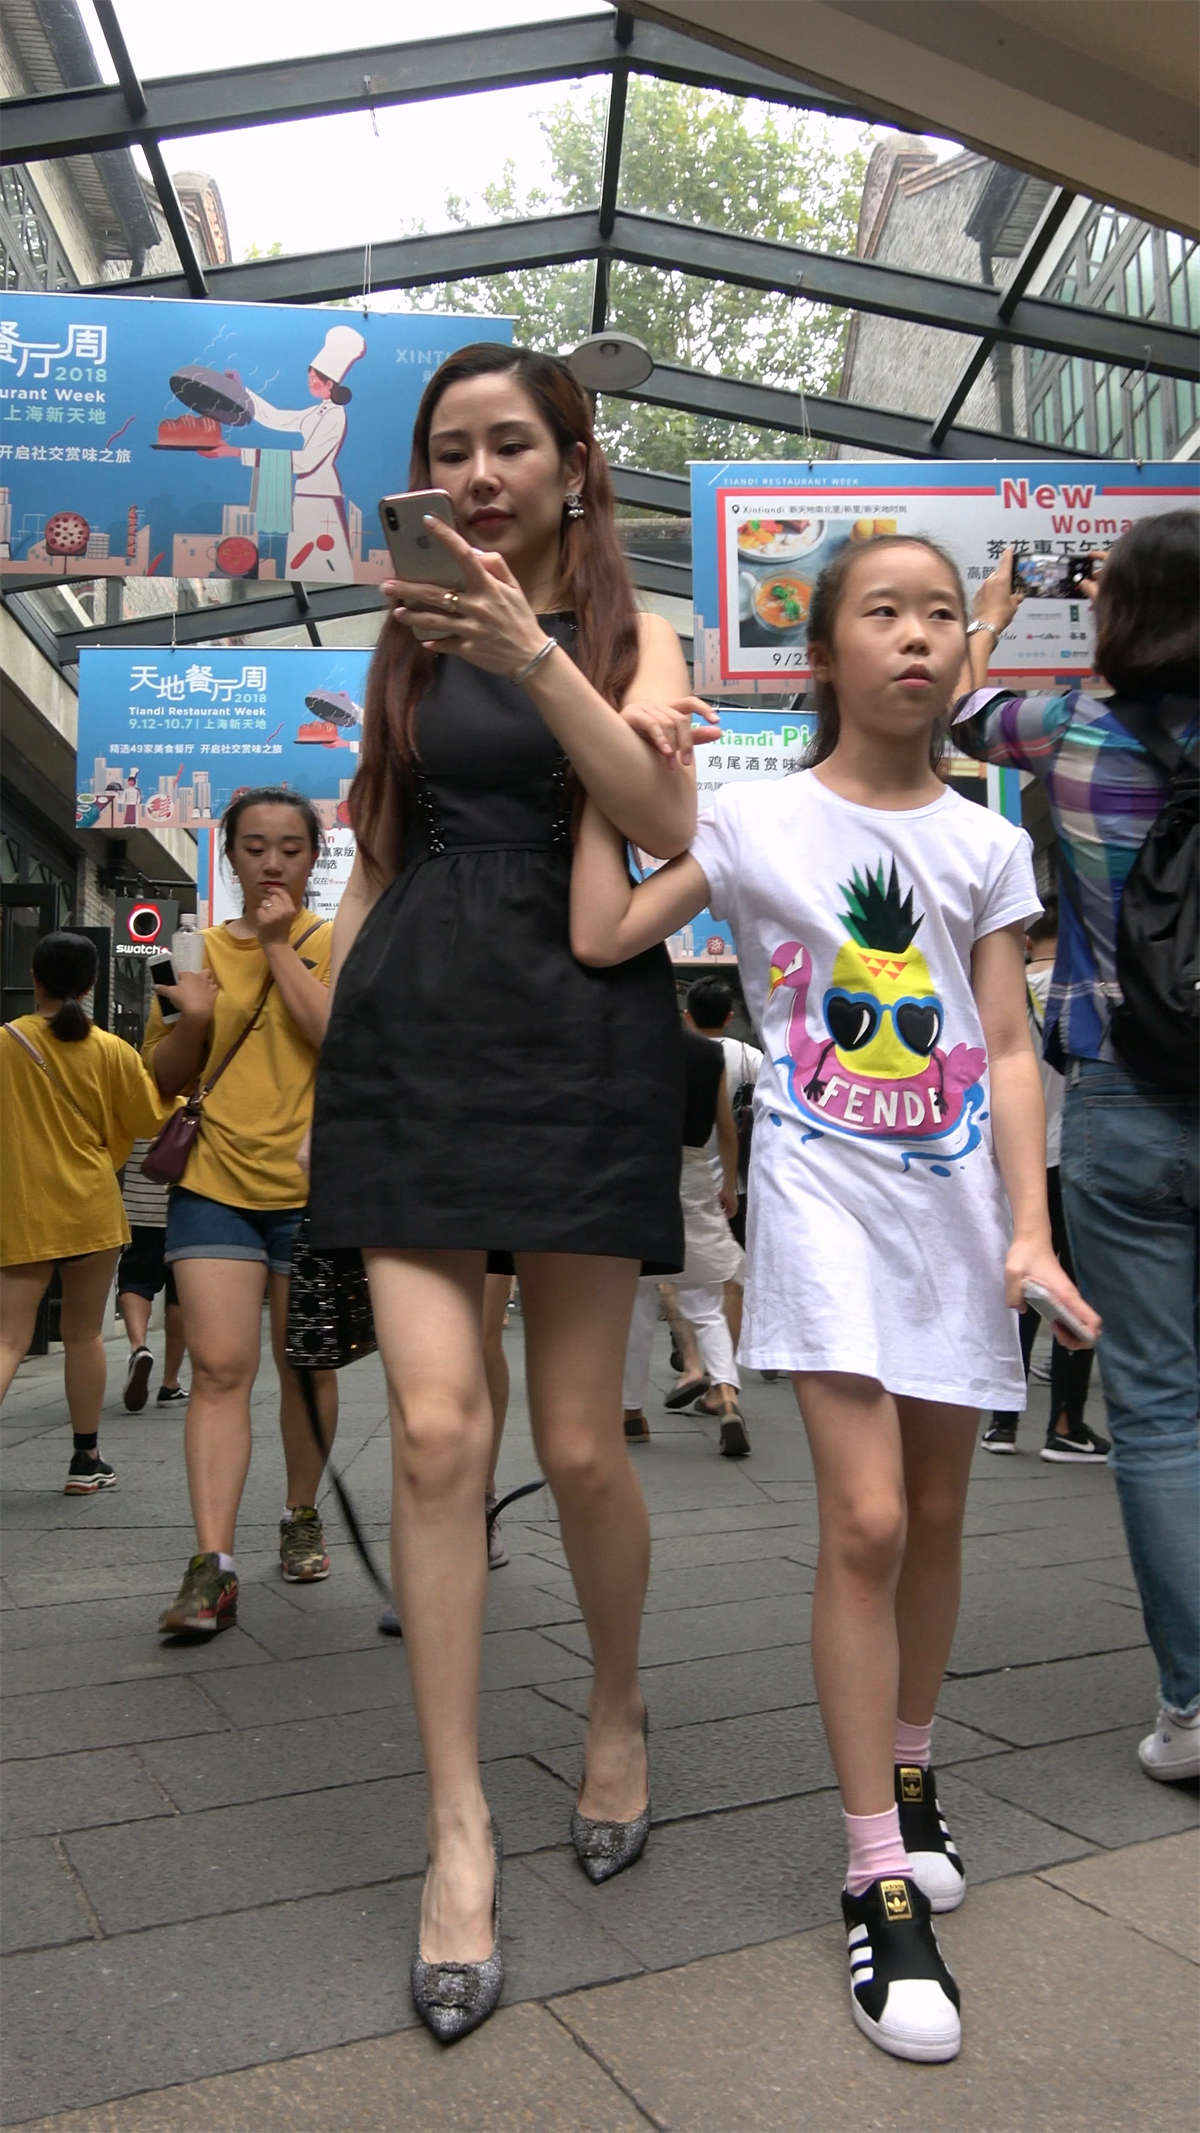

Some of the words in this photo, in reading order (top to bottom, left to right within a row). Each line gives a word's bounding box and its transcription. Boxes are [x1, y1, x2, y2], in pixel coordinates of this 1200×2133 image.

[395, 349, 450, 365] XINT
[55, 366, 107, 383] 2018
[55, 388, 106, 403] Week
[4, 404, 106, 424] 上海新天地
[0, 445, 132, 463] 开启社交赏味之旅
[762, 478, 828, 486] RESTAURANT
[831, 478, 860, 486] WEEK
[1002, 480, 1095, 509] New
[129, 664, 267, 702] 天地餐厅周
[235, 693, 267, 703] 2018
[129, 706, 165, 716] Tiandi
[168, 706, 231, 716] Restaurant
[235, 706, 267, 716] Week
[129, 718, 192, 730] 9.12-10.7
[205, 718, 267, 730] 上海新天地
[712, 729, 774, 746] tiandi
[200, 743, 283, 755] 开启社交赏味之旅
[707, 756, 797, 771] 鸡尾酒赏味
[116, 944, 160, 955] swatch
[818, 1075, 943, 1127] FENDI
